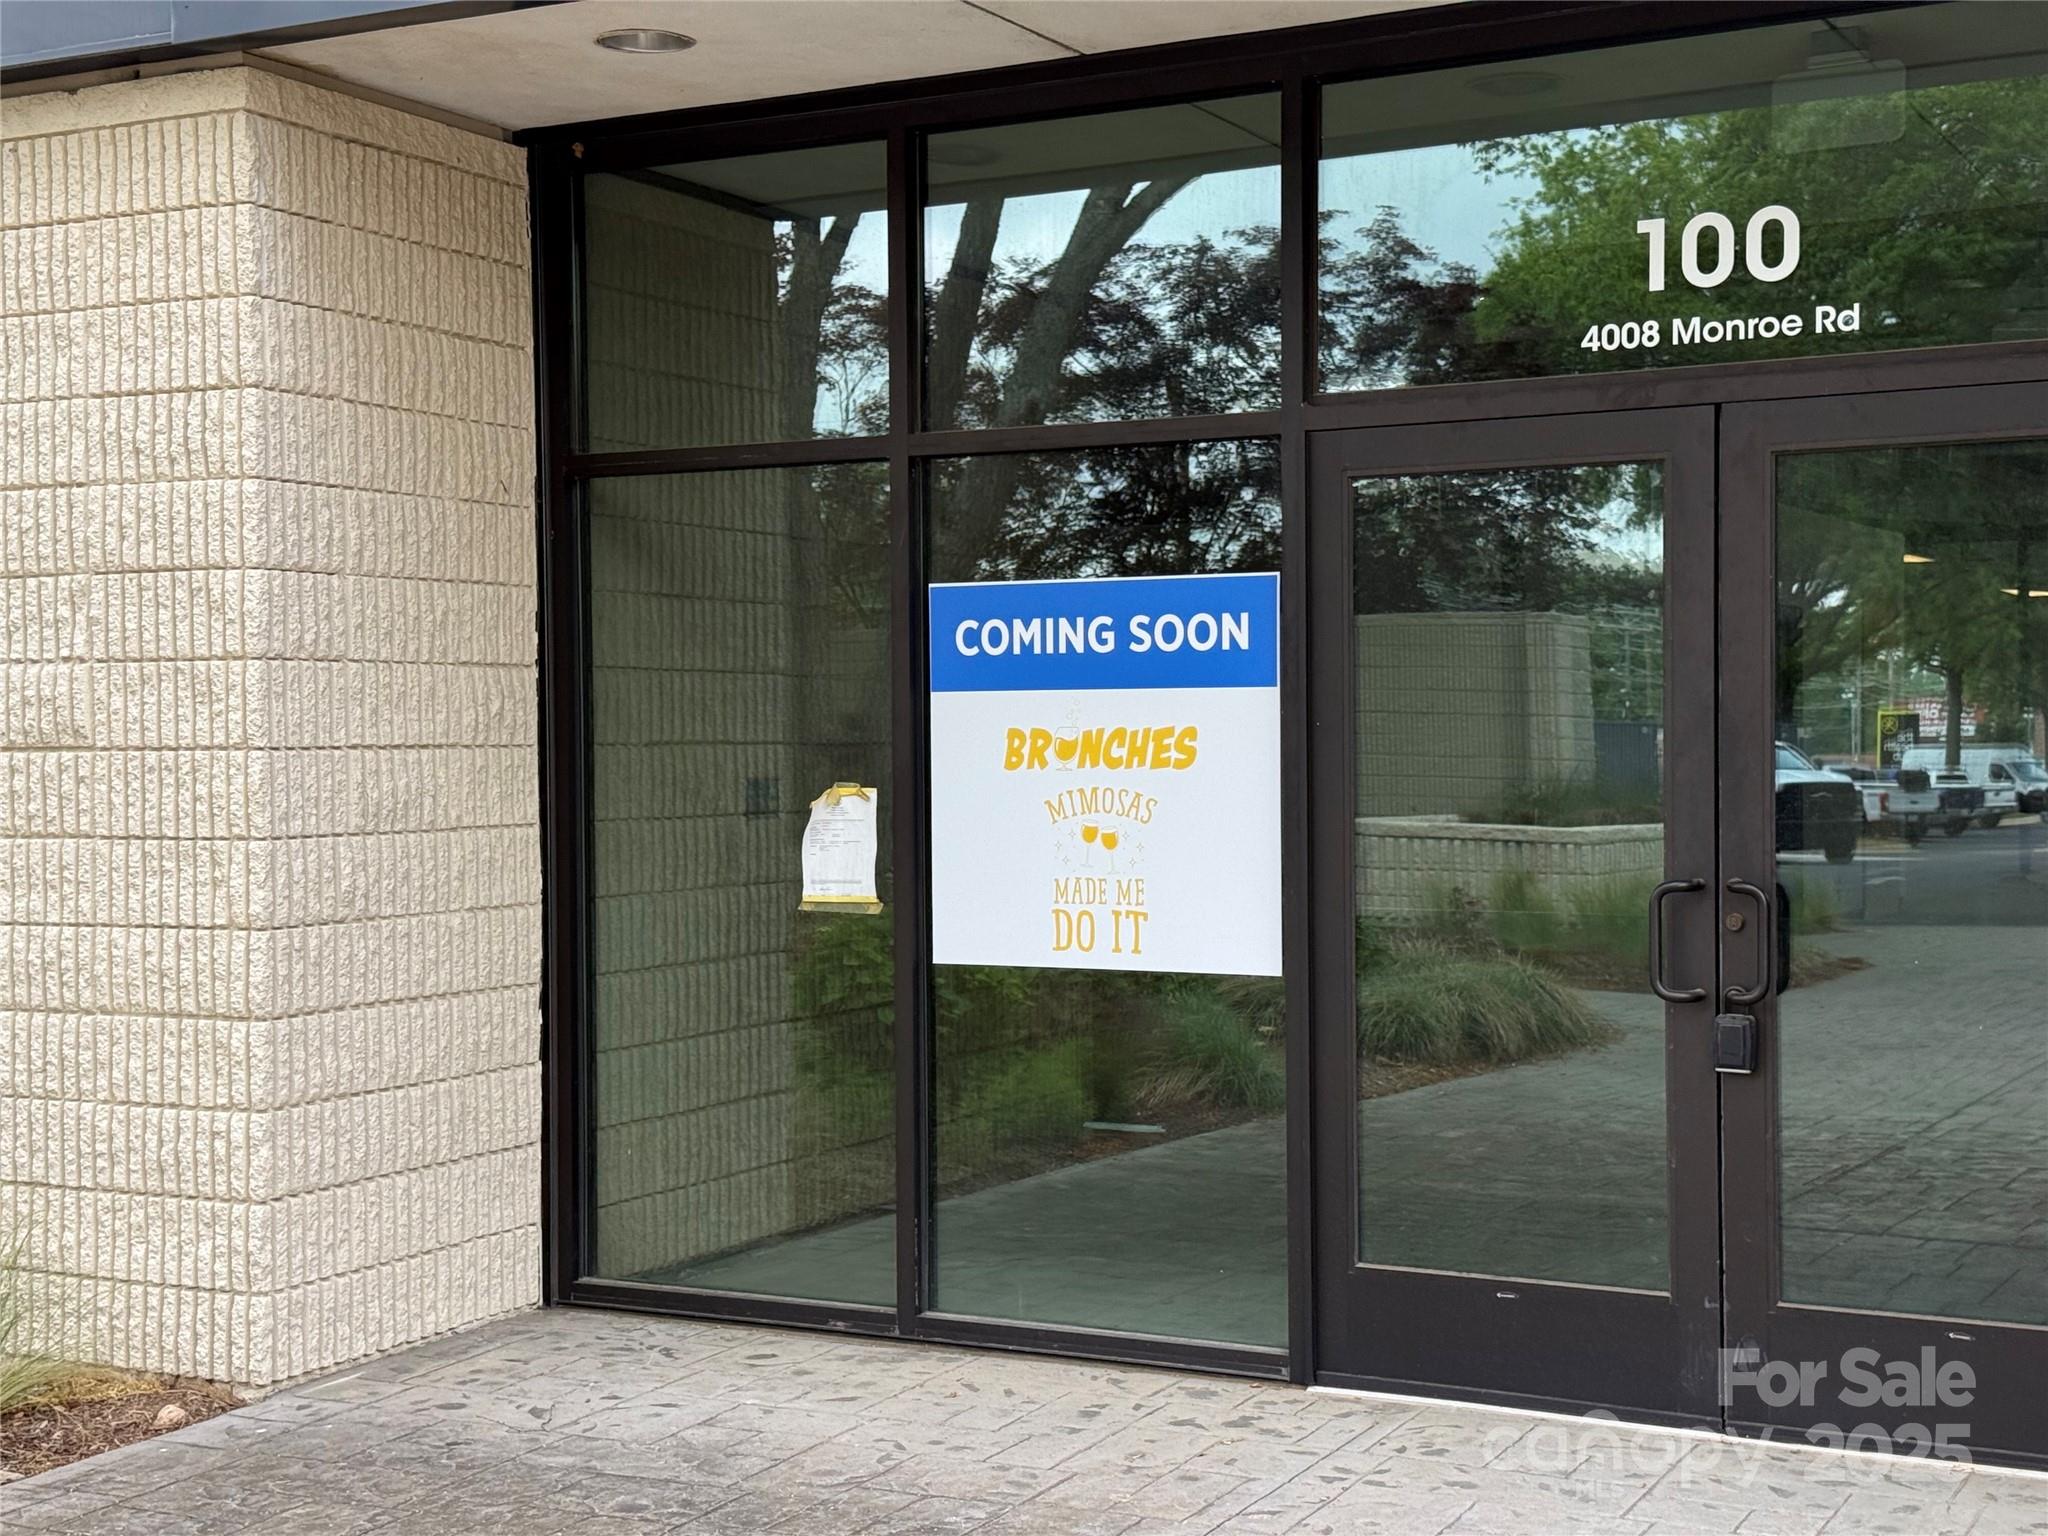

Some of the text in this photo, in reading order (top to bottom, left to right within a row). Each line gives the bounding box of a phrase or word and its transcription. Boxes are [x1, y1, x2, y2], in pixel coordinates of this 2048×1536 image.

[1636, 204, 1800, 292] 100
[1580, 302, 1860, 352] 4008 Monroe Rd
[955, 611, 1249, 657] COMING SOON
[1044, 786, 1158, 825] MIMOSAS
[1054, 877, 1145, 906] MADE ME
[1052, 908, 1148, 955] DO IT
